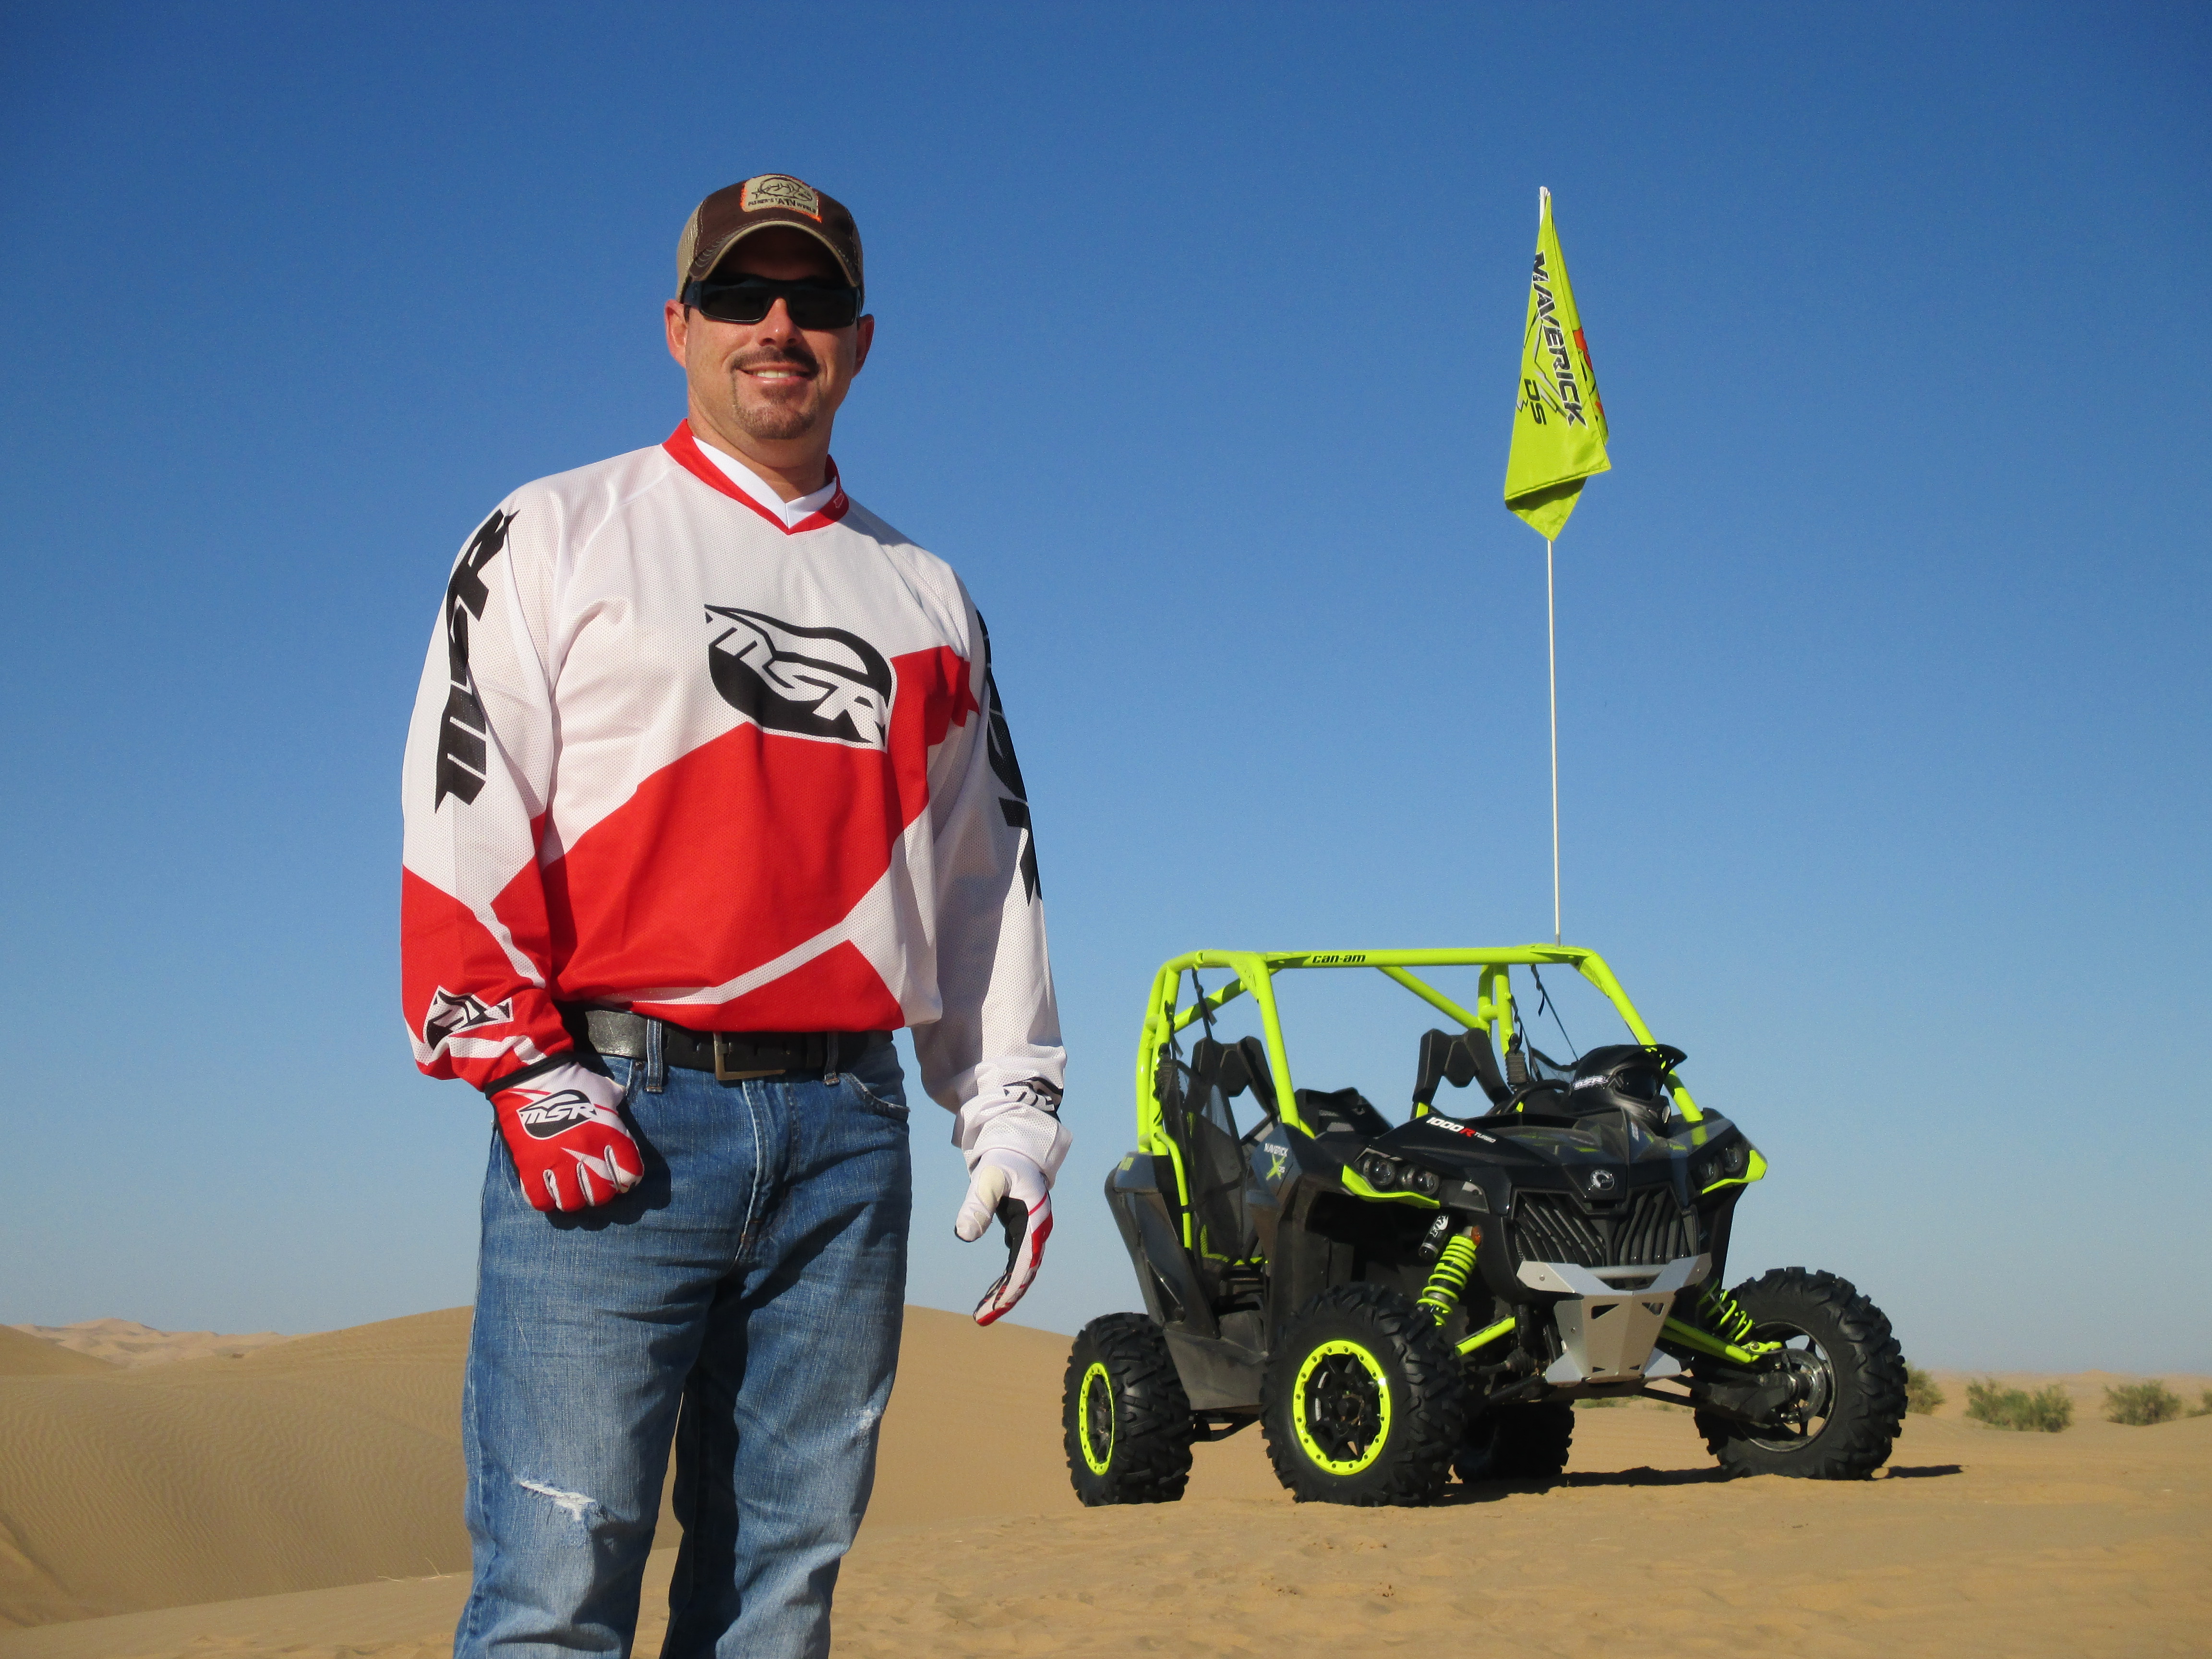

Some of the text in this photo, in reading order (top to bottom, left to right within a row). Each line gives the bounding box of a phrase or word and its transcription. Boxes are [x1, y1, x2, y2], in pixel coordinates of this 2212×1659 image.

[796, 202, 816, 214] WORLD
[1532, 250, 1588, 429] MAVERICK
[1524, 378, 1547, 425] DS
[704, 605, 889, 747] MSR
[1312, 954, 1366, 964] can-am
[1574, 1076, 1607, 1090] MSR
[1426, 1117, 1497, 1143] 1000R TURBO
[1263, 1142, 1289, 1157] MAVERICK
[1430, 1214, 1449, 1238] FOX
